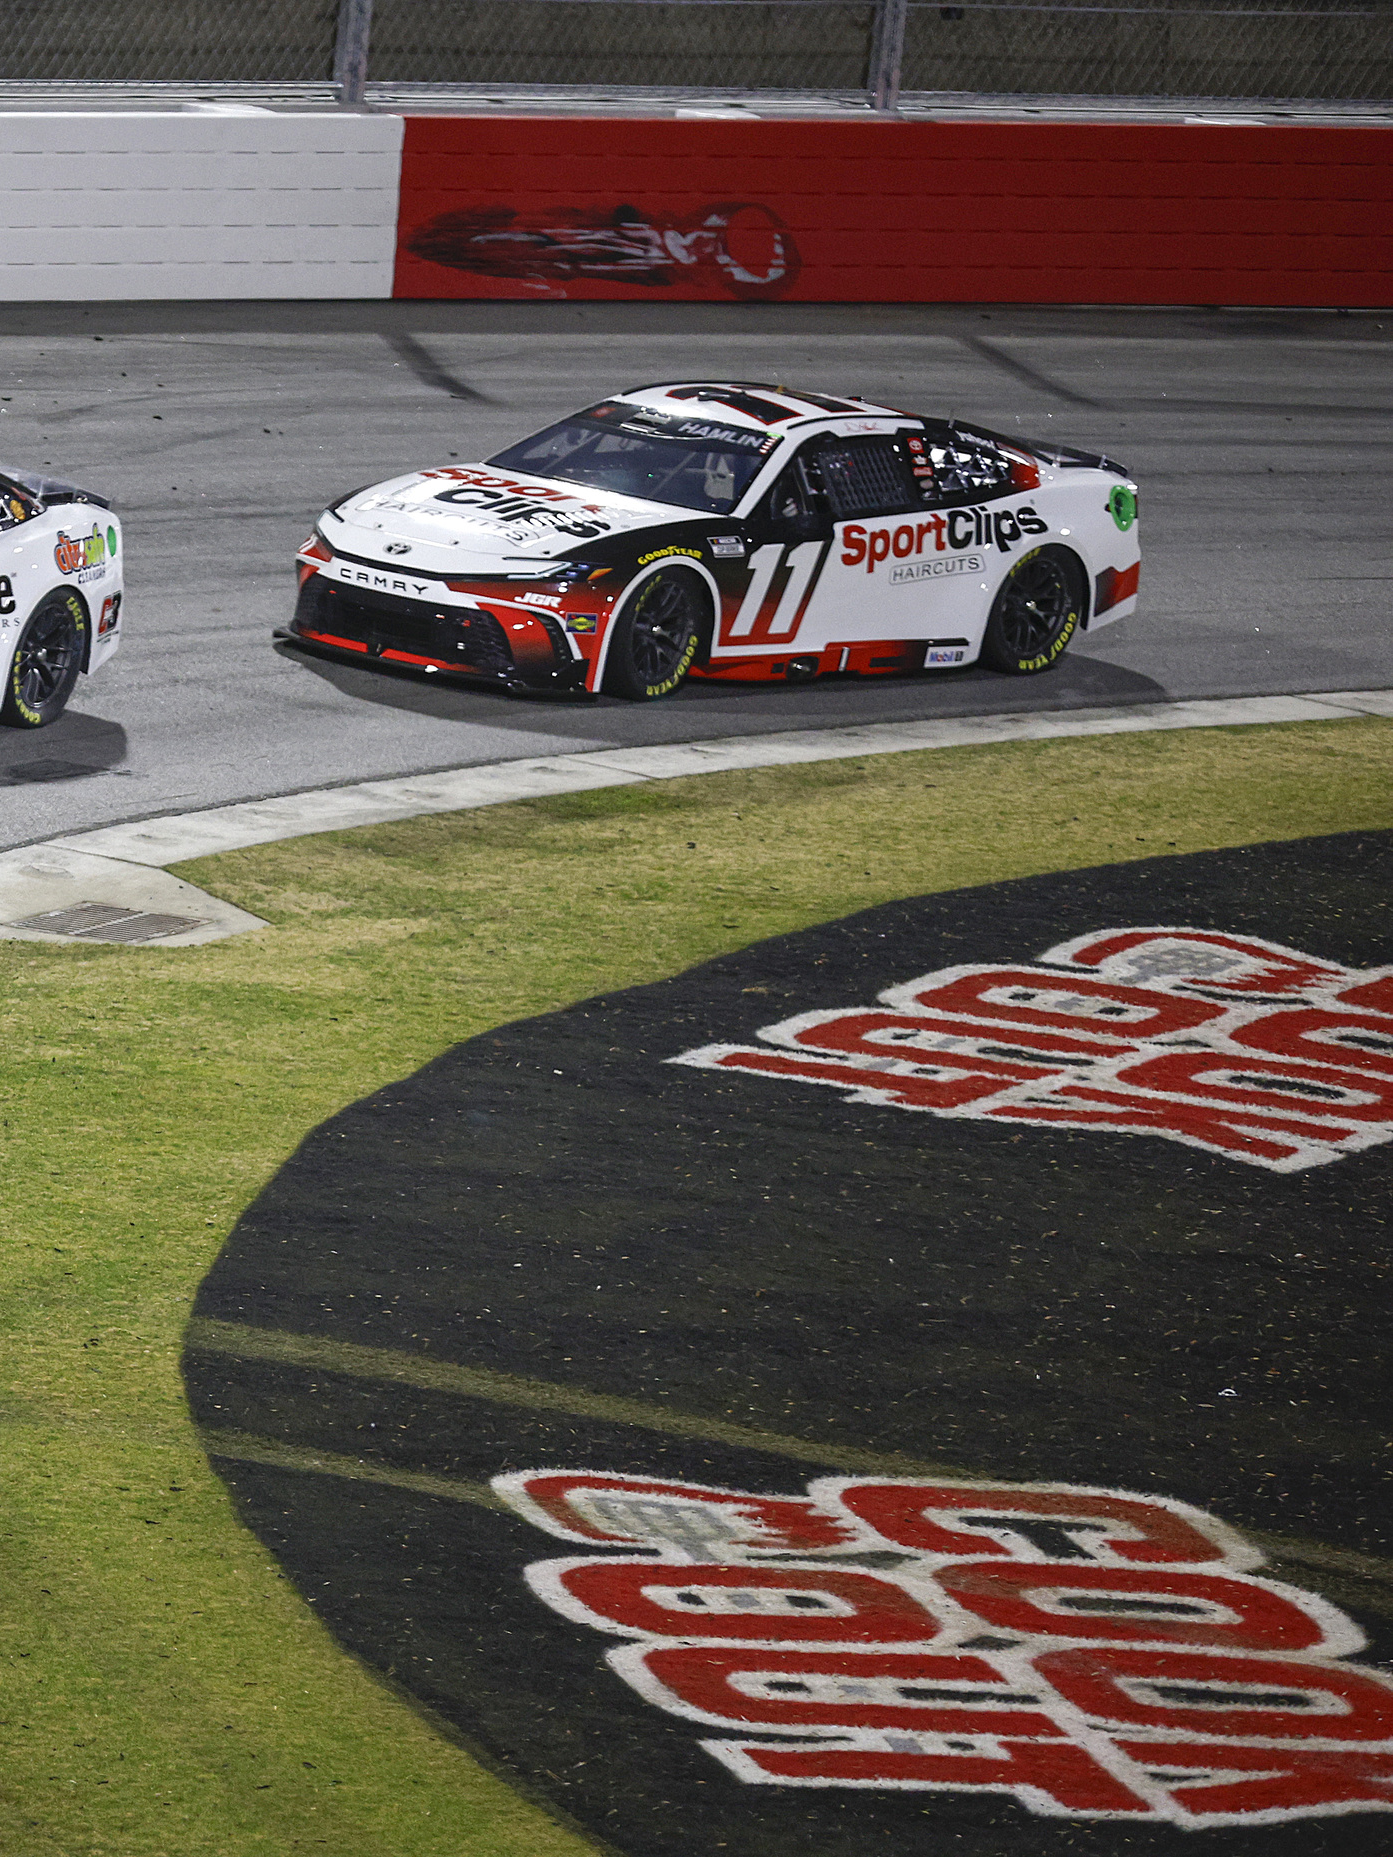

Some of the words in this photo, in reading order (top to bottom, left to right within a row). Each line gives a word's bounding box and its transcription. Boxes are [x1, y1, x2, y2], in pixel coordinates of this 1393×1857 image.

[678, 422, 764, 448] HAMLIN
[637, 545, 704, 565] GOODYEAR
[340, 567, 429, 595] CAMRY
[893, 557, 980, 582] HAIRCUTS
[515, 592, 562, 607] JGR
[728, 540, 824, 637] 11
[66, 596, 85, 632] EAGLE
[1018, 612, 1077, 670] GOODYEAR
[929, 651, 954, 663] Mobil
